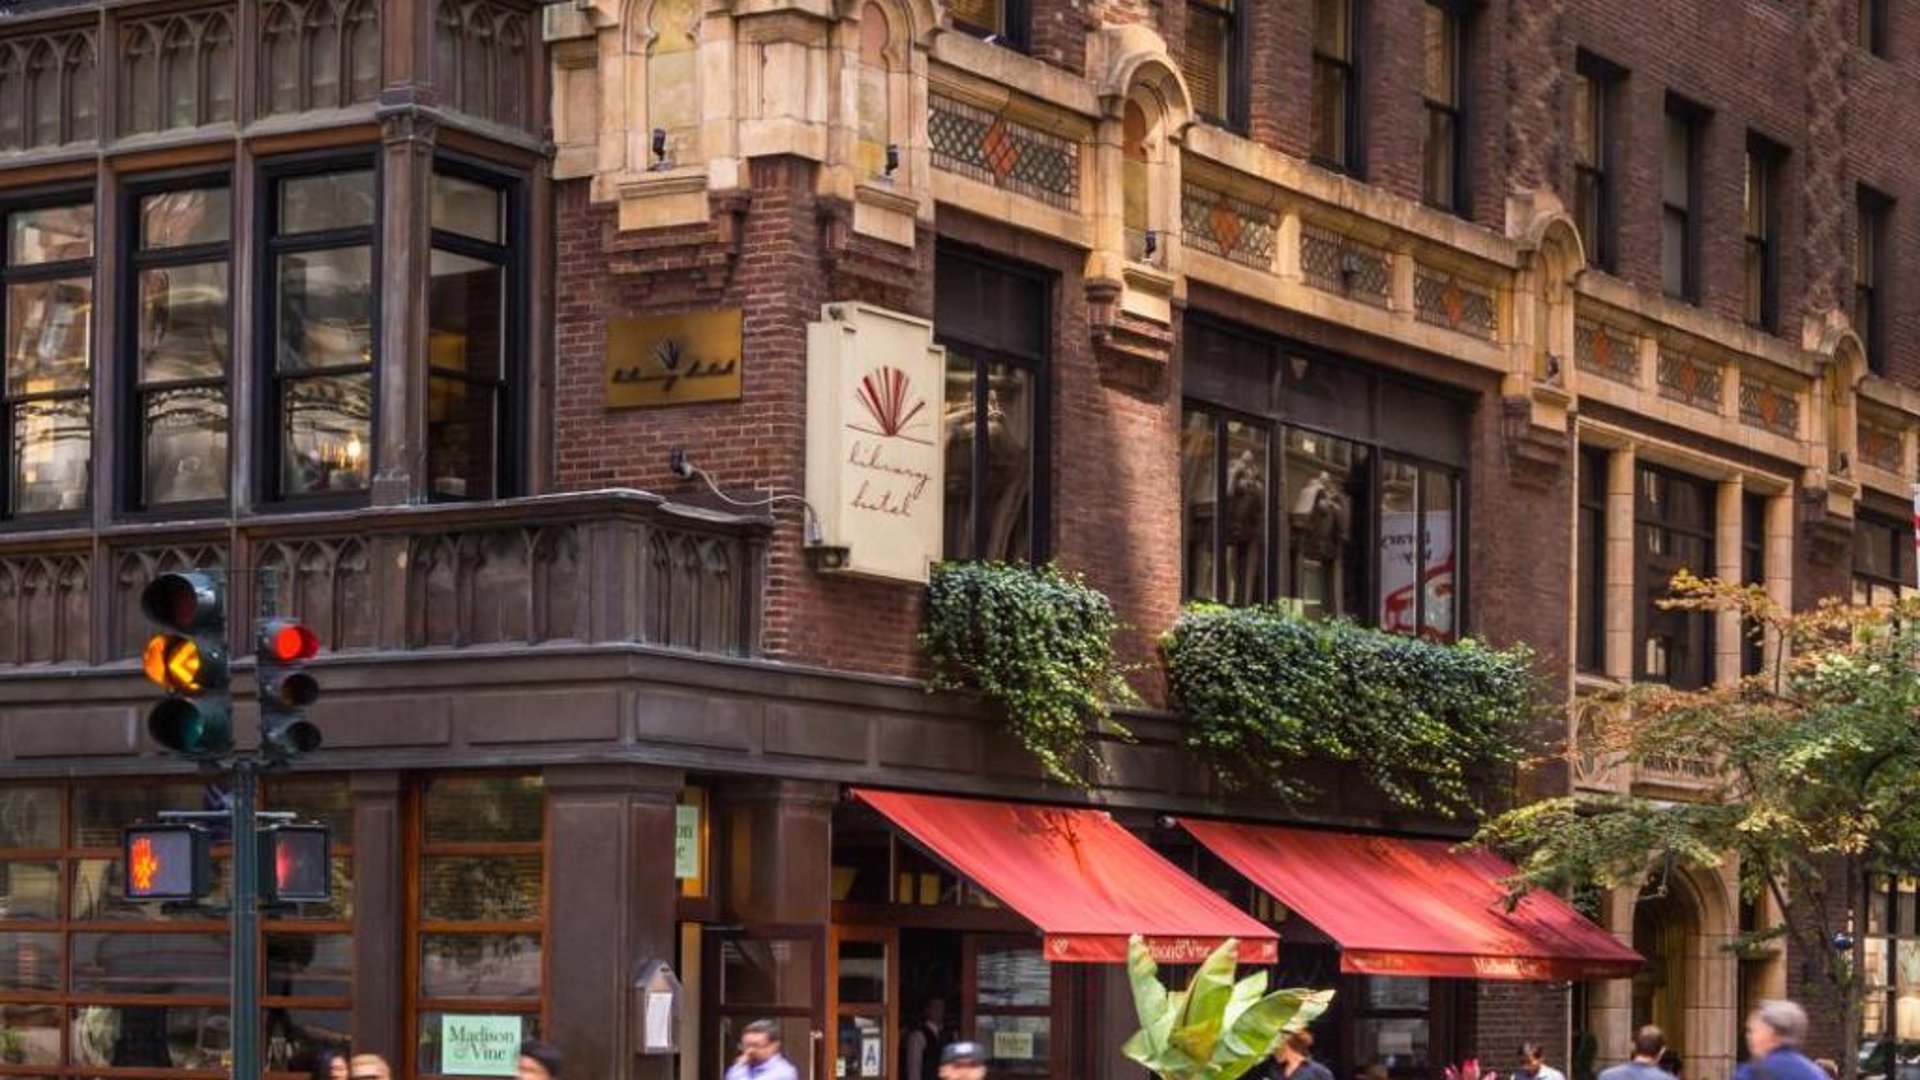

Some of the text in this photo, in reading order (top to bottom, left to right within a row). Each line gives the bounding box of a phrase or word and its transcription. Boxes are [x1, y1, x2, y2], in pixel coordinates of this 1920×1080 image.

[847, 440, 932, 501] library
[850, 479, 911, 517] hotel
[449, 1025, 515, 1043] Madison
[470, 1042, 507, 1060] Vine
